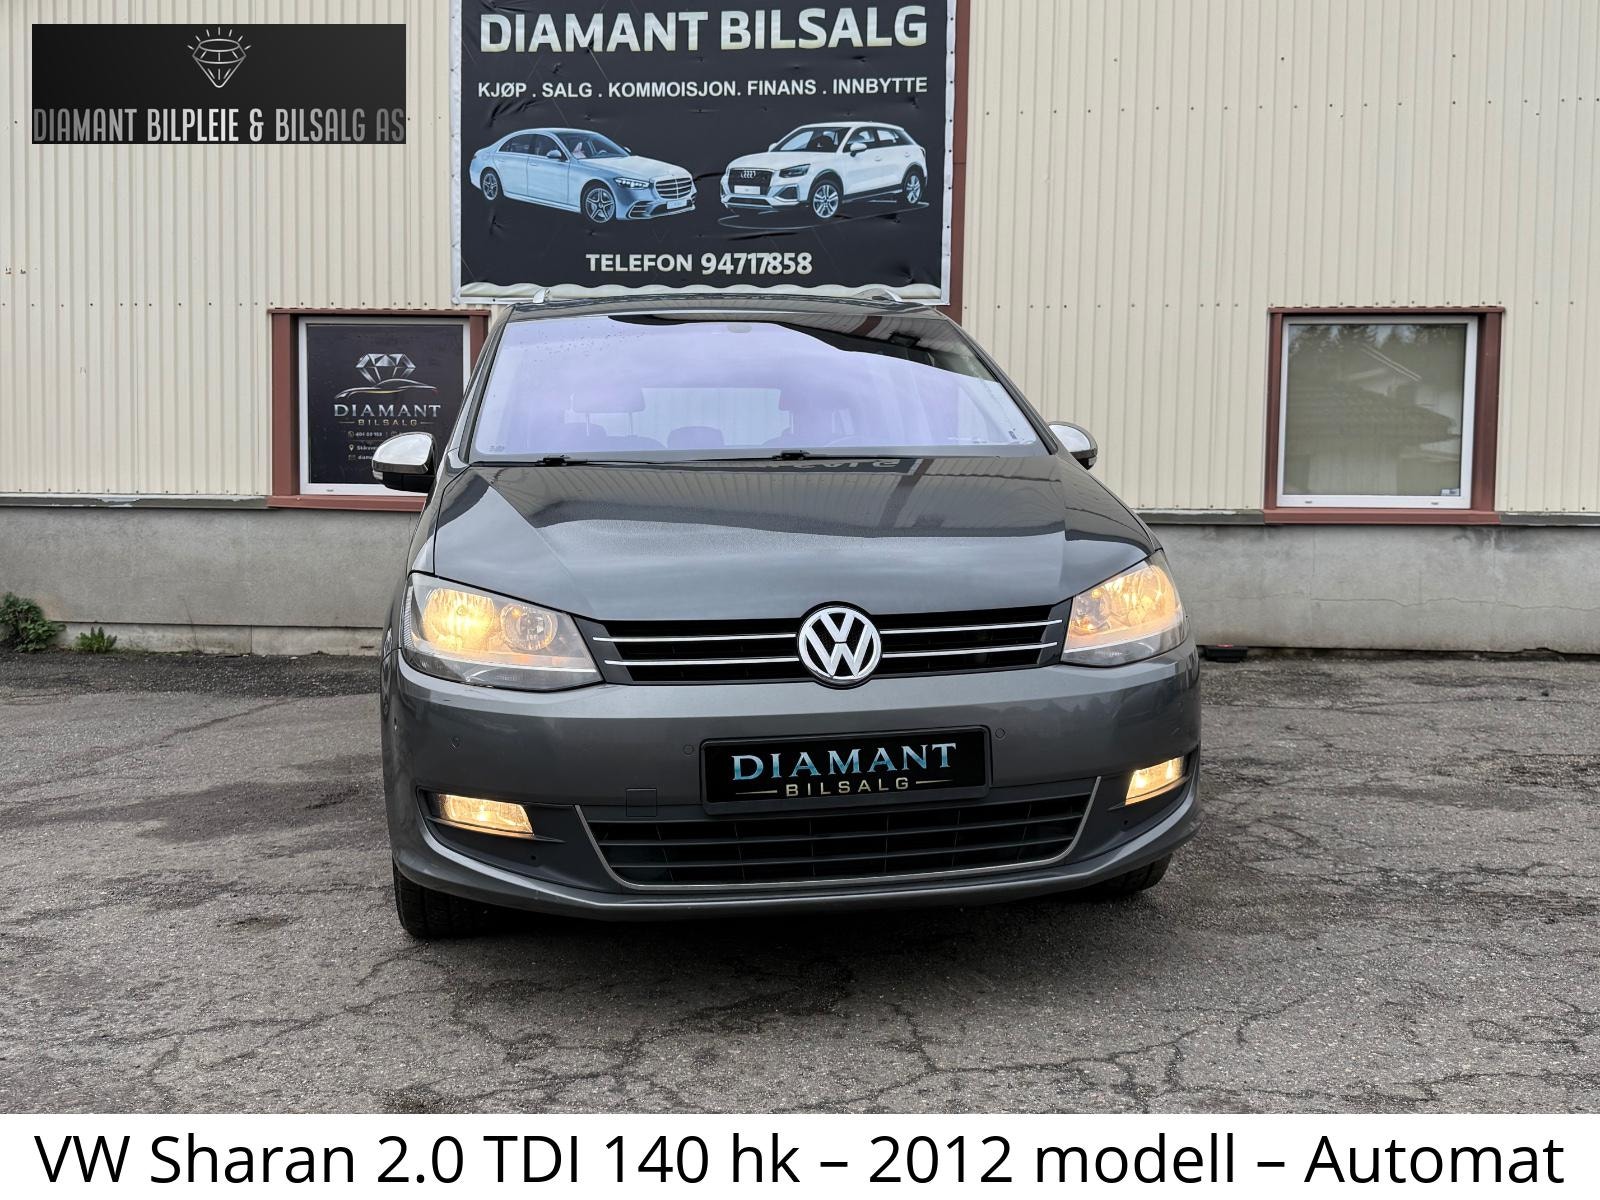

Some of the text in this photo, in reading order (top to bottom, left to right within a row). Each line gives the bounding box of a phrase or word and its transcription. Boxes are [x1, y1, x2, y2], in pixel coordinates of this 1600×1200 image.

[480, 6, 927, 53] DIAMANT BILSALG
[478, 82, 527, 98] KJØP
[542, 82, 593, 98] SALG
[608, 81, 741, 98] KOMMOISJON.
[747, 79, 817, 96] FINANS
[833, 77, 928, 95] INNBYTTE
[586, 252, 813, 275] TELEFON 94717858
[334, 404, 441, 417] DIAMANT
[731, 742, 957, 781] DIAMANT
[786, 777, 909, 797] BILSALG
